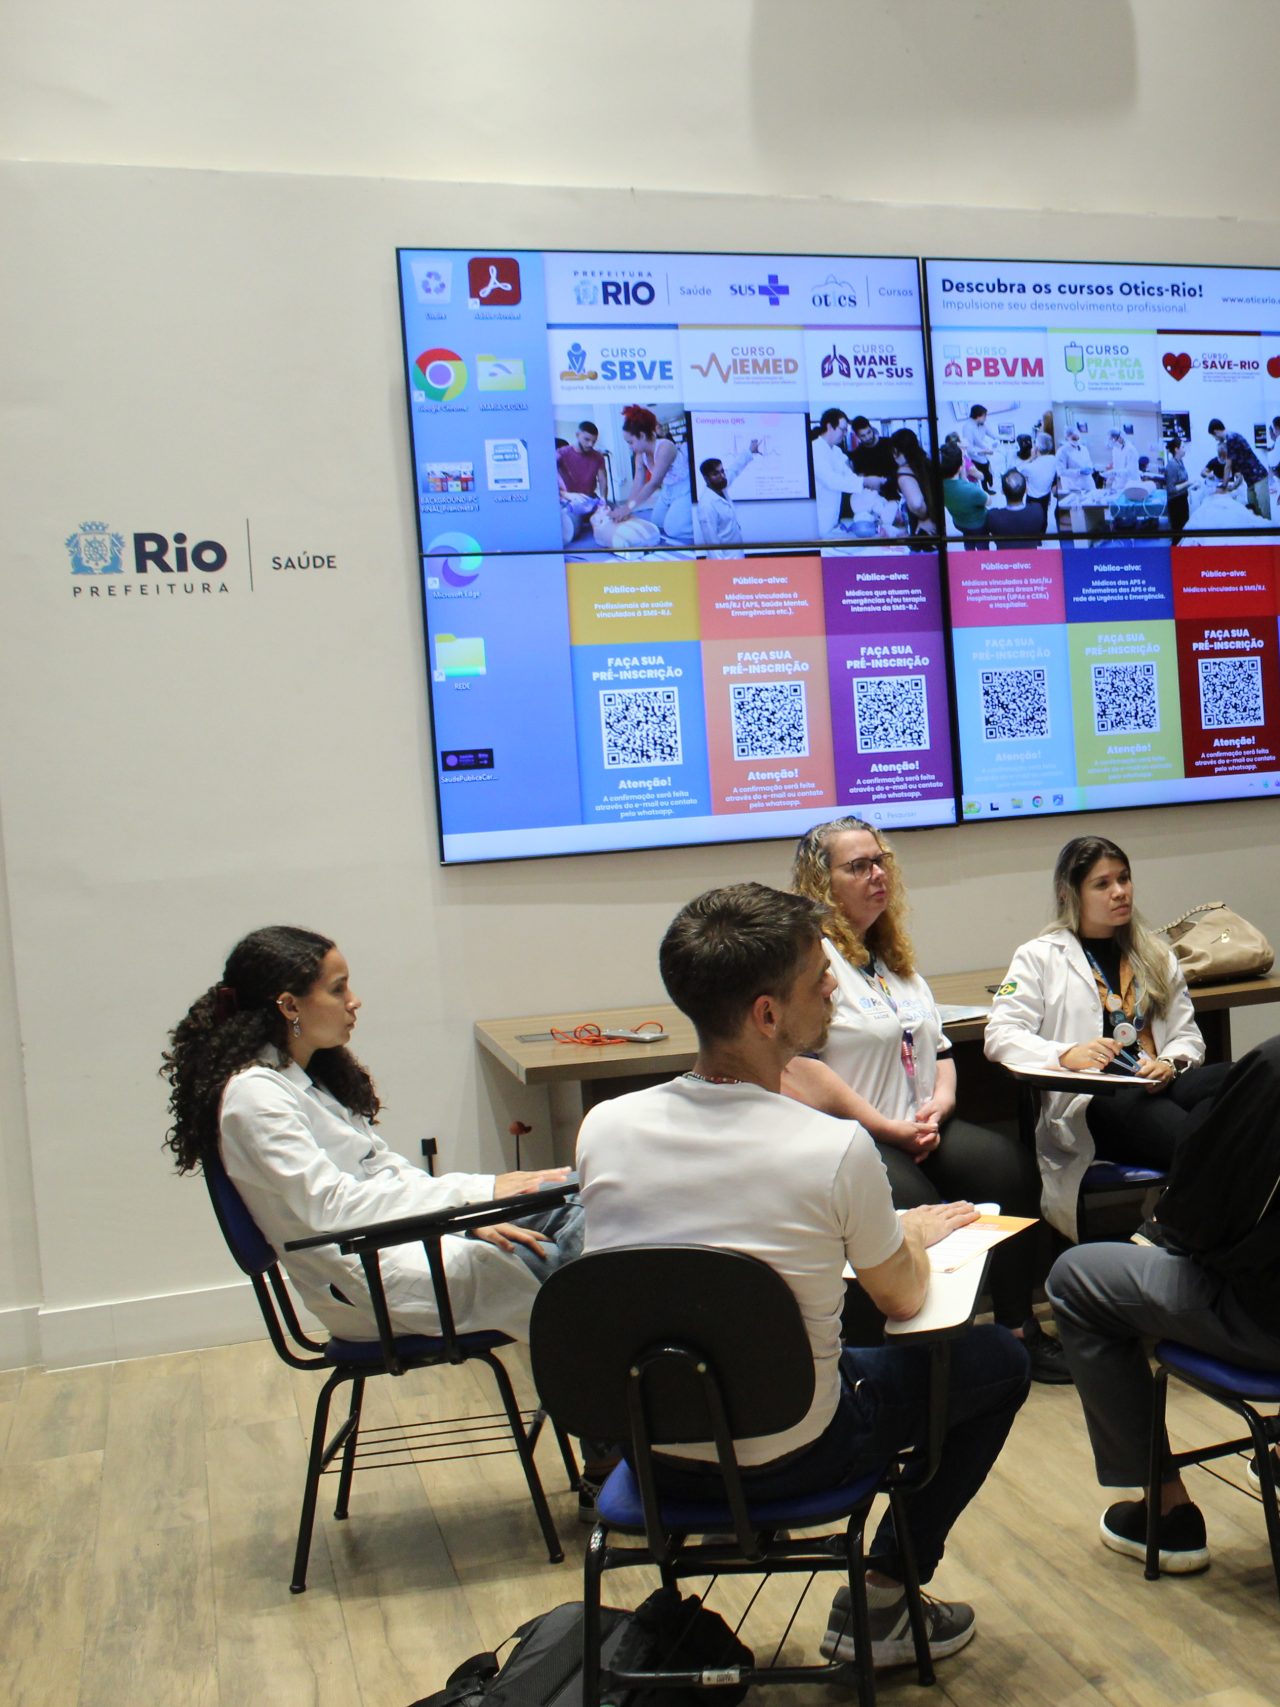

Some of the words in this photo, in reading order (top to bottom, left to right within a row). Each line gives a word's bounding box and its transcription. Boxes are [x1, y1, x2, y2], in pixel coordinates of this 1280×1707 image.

[602, 281, 655, 306] RIO
[680, 286, 712, 296] Saúde
[730, 284, 755, 296] SUS
[879, 287, 913, 296] Cursos
[942, 279, 1026, 293] Descubra
[1032, 284, 1051, 294] os
[1058, 284, 1113, 296] cursos
[1119, 281, 1203, 298] Otics-Rio!
[943, 299, 1004, 311] Impulsione
[1008, 302, 1027, 310] seu
[1030, 301, 1123, 312] desenvolvimento
[601, 348, 647, 358] CURSO
[732, 347, 774, 355] CURSO
[853, 345, 894, 353] CURSO
[967, 347, 1007, 355] CURSO
[1086, 345, 1129, 355] CURSO
[733, 358, 798, 374] IEMED
[854, 355, 897, 366] MANE
[1202, 360, 1259, 370] SAVE-RIO
[601, 360, 673, 381] SBVE
[856, 367, 913, 378] VA-SUS
[967, 358, 1044, 377] PBVM
[1088, 369, 1144, 380] VA-SUS
[133, 532, 227, 573] Rio
[272, 551, 336, 570] SAÚDE
[1094, 564, 1141, 572] Público-alvo:
[856, 573, 908, 581] Público-alvo:
[73, 583, 229, 597] PREFEITURA
[433, 591, 463, 599] Microsoft
[464, 591, 481, 599] Edge
[604, 585, 661, 594] Público-alvo:
[1098, 634, 1124, 644] FAÇA
[1126, 633, 1144, 641] SUA
[1205, 630, 1230, 640] FAÇA
[1231, 629, 1249, 637] SUA
[1086, 643, 1160, 656] PRÉ-INSCRIÇÃO
[1193, 638, 1264, 651] PRÉ-INSCRIÇÃO
[737, 652, 767, 663] FAÇA
[769, 651, 791, 659] SUA
[860, 647, 889, 658] FAÇA
[891, 646, 913, 654] SUA
[608, 657, 639, 669] FAÇA
[641, 656, 664, 665] SUA
[723, 661, 809, 675] PRÉ-INSCRIÇÃO
[847, 655, 929, 669] PRÉ-INSCRIÇÃO
[592, 666, 682, 681] PRÉ-INSCRIÇÃO
[1214, 736, 1255, 748] Atenção!
[1107, 744, 1152, 755] Atenção!
[871, 760, 919, 773] Atenção!
[747, 769, 799, 781] Atenção!
[619, 777, 671, 790] Atenção!
